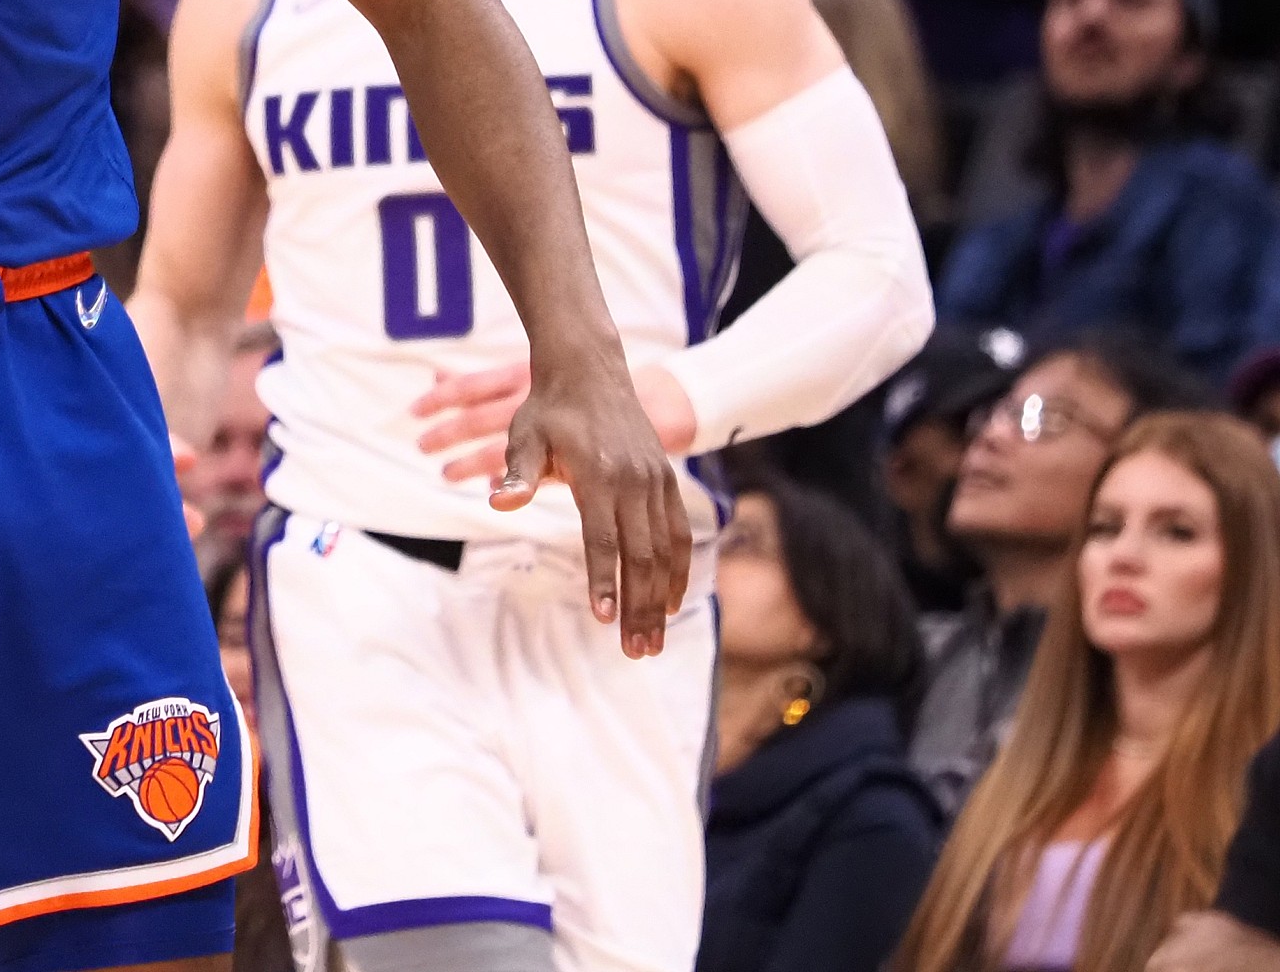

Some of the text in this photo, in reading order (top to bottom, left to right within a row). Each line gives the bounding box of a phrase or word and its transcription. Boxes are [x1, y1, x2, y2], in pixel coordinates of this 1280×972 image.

[378, 192, 473, 341] 0
[98, 710, 219, 779] KNICKS
[137, 704, 190, 724] NEW YORK
